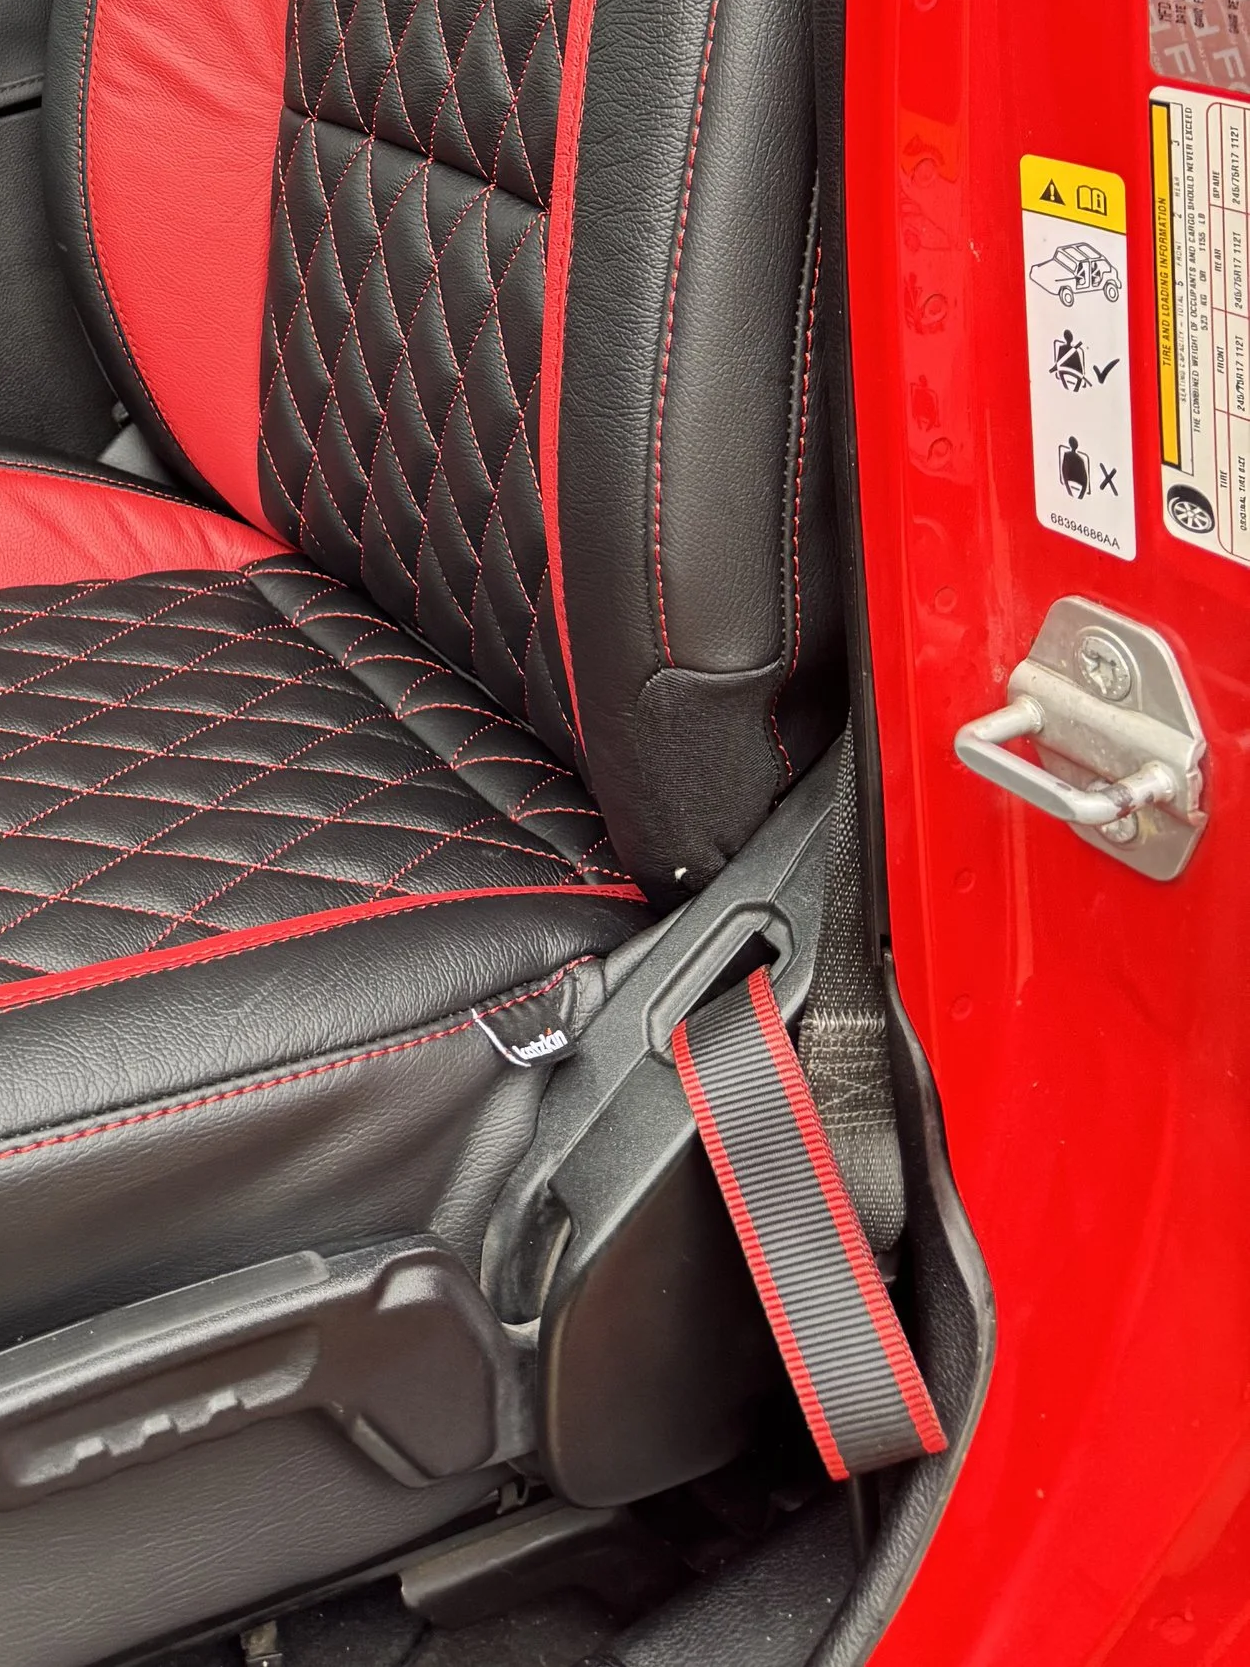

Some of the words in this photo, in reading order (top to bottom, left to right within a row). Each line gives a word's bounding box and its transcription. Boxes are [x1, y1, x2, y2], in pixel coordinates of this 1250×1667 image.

[1158, 2, 1171, 21] MFD
[1185, 108, 1193, 141] EXCEED
[1230, 126, 1239, 148] 112T
[1186, 176, 1195, 210] SHOULD
[1212, 171, 1220, 198] SPARE
[1187, 213, 1195, 243] CARGO
[1198, 213, 1205, 225] LB
[1158, 198, 1168, 268] INFORMATION
[1198, 232, 1206, 252] 1155
[1232, 232, 1241, 255] 112T
[1188, 246, 1196, 264] AND
[1214, 249, 1222, 272] REAR
[1199, 270, 1207, 282] OR
[1160, 272, 1170, 316] LOADING
[1188, 267, 1197, 318] OCCUPANTS
[1200, 294, 1207, 306] KG
[1161, 320, 1170, 341] AND
[1190, 321, 1198, 331] OF
[1162, 344, 1172, 367] TIRE
[1191, 335, 1199, 367] WEIGHT
[1235, 333, 1243, 357] 112T
[1216, 346, 1225, 374] FRONT
[1220, 470, 1228, 488] TIRE
[1050, 513, 1120, 550] 68394686AA
[512, 1028, 568, 1060] katzkin
